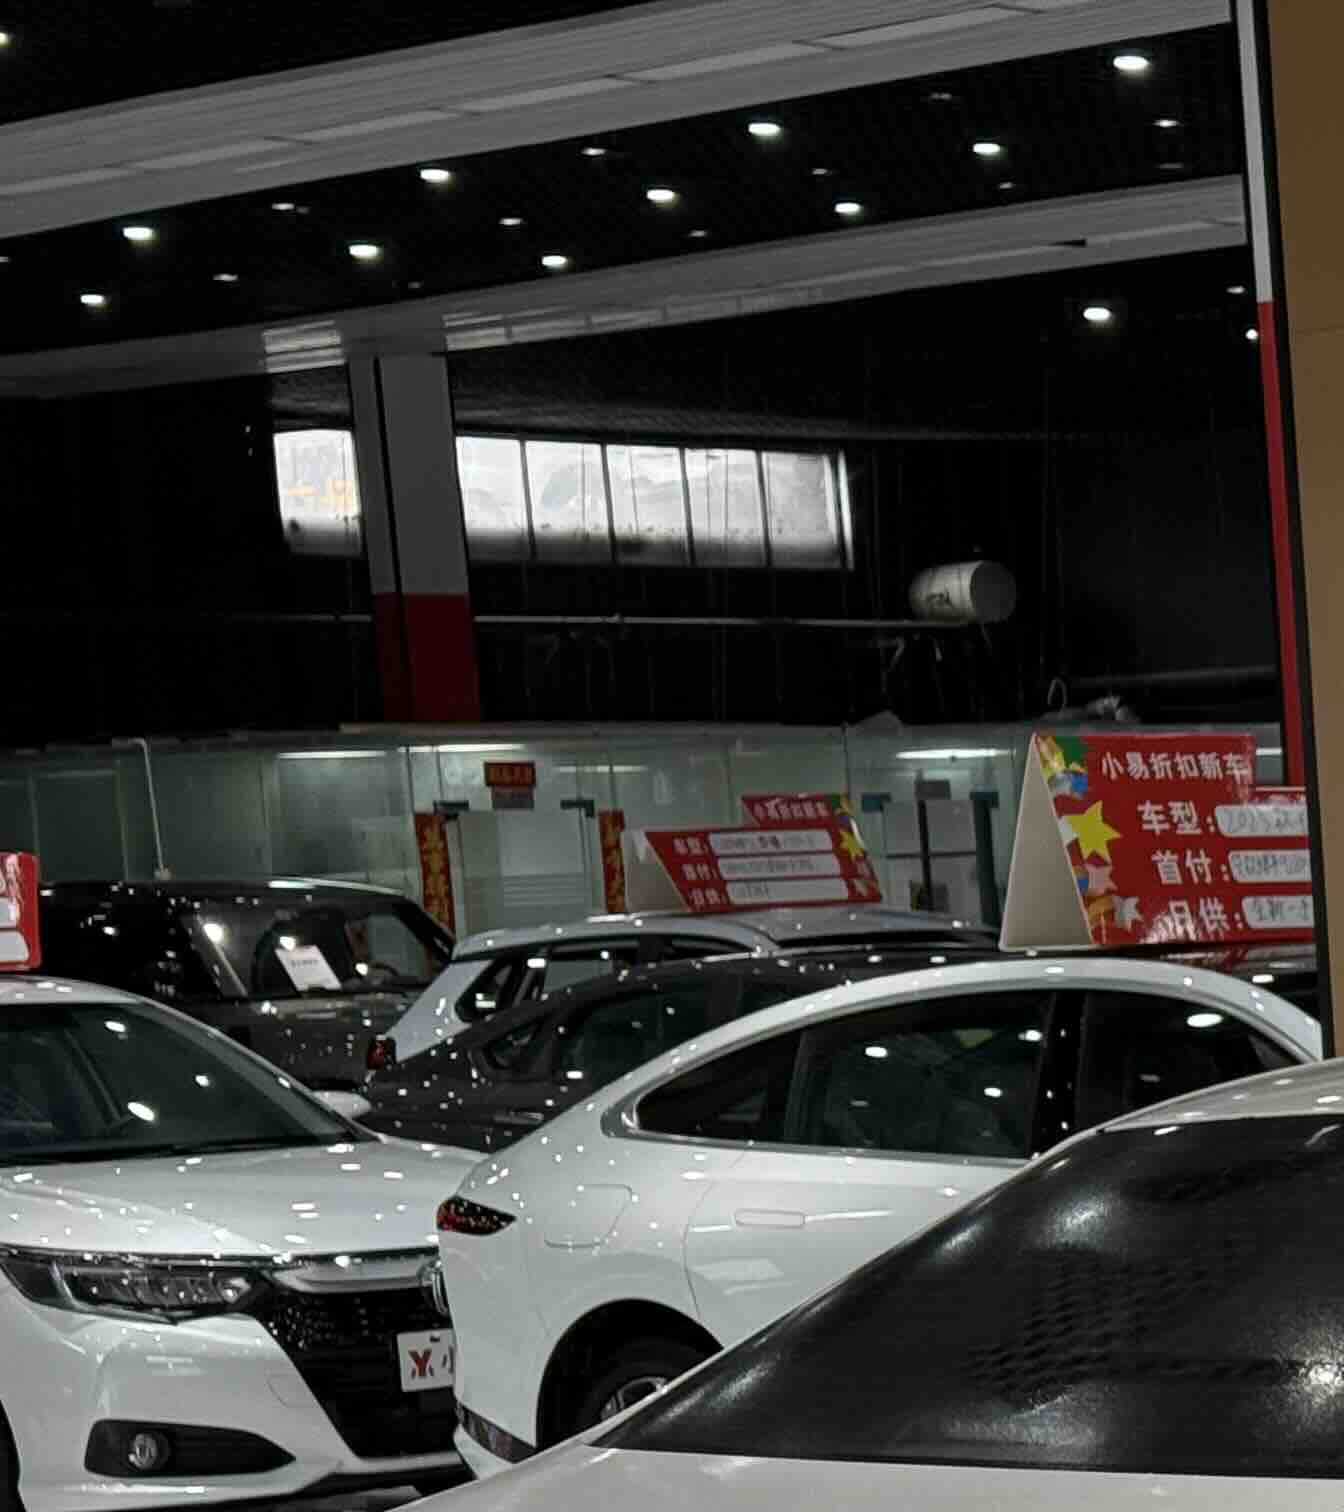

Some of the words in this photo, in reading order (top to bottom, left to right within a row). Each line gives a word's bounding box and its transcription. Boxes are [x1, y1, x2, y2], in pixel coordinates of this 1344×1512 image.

[1102, 751, 1251, 785] 小易折扣新车
